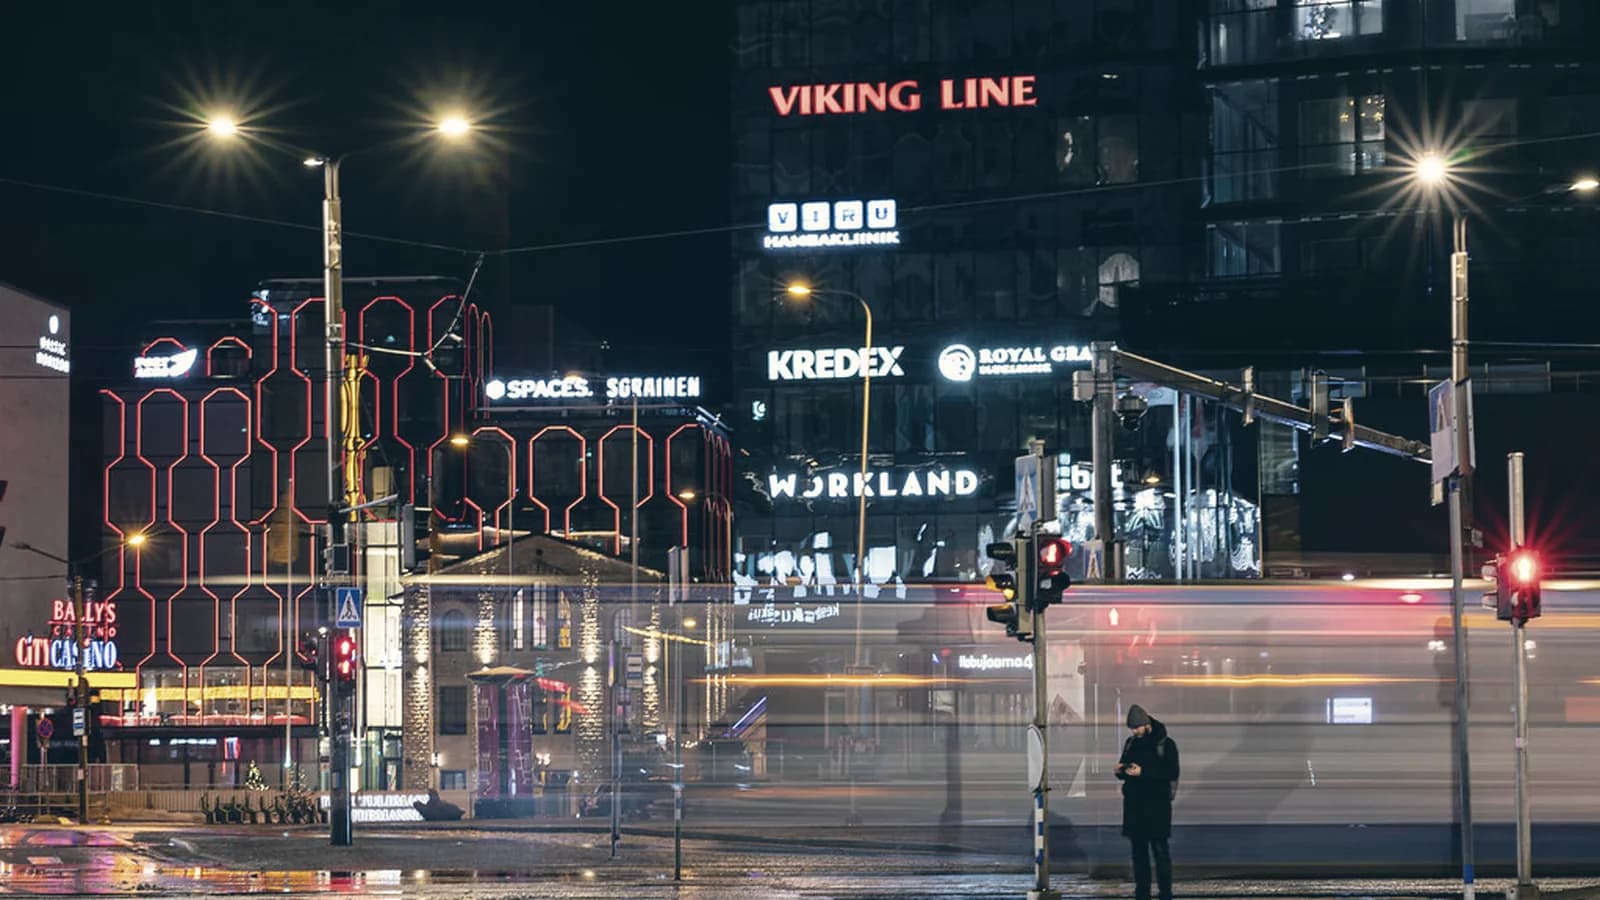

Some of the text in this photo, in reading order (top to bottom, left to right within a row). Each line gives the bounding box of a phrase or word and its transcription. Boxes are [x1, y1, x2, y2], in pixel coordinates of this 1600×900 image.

[768, 75, 1038, 116] VIKING LINE
[773, 204, 892, 227] VIRU
[768, 346, 905, 381] KREDEX
[979, 347, 1046, 363] ROYAL
[53, 625, 117, 636] CAINO
